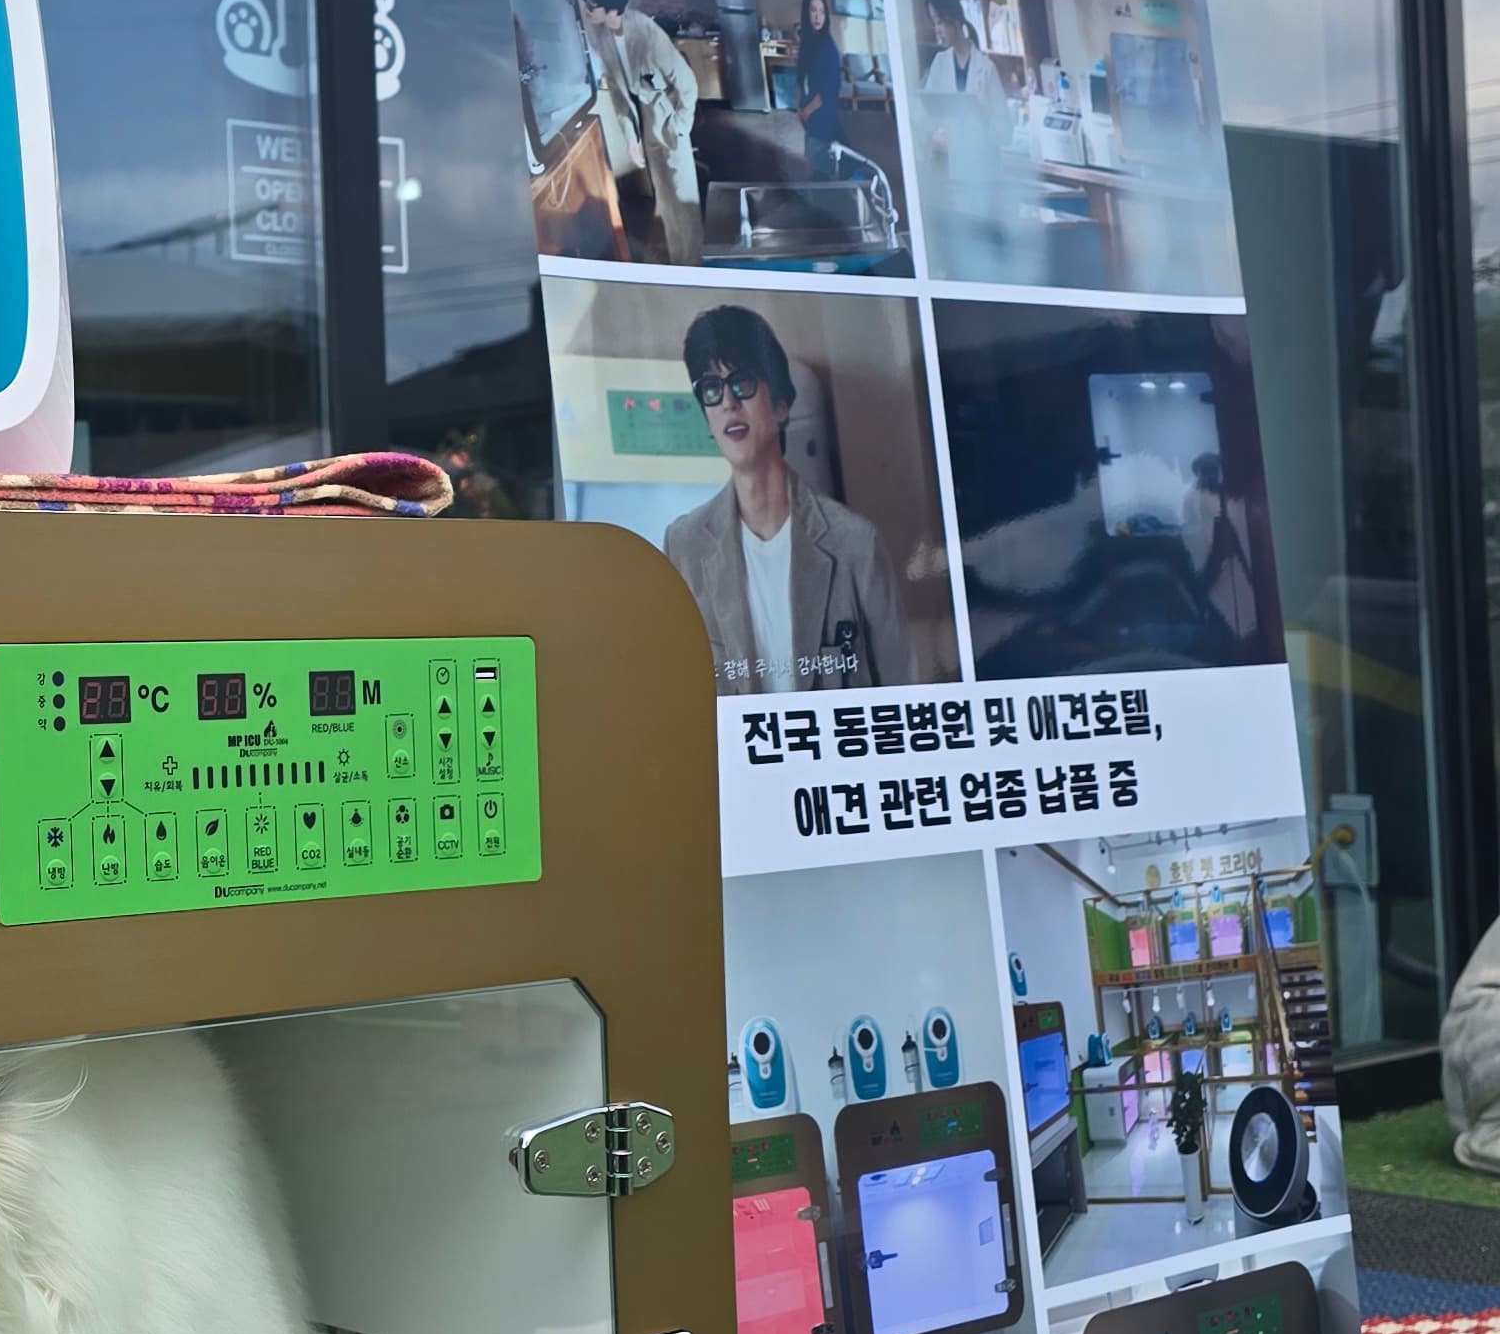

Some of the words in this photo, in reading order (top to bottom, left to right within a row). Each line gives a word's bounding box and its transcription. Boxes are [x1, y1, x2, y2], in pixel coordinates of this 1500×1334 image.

[798, 653, 859, 676] 감사합니다
[362, 680, 381, 705] M
[311, 722, 355, 735] RED/BLUE
[742, 709, 821, 765] 전국
[834, 699, 975, 758] 동물병원
[984, 697, 1020, 745] 및
[1027, 689, 1162, 742] 애견호텔,
[227, 735, 242, 747] MP
[244, 734, 261, 747] ICU
[477, 765, 501, 776] MUSIC
[794, 782, 871, 837] 애견
[880, 775, 951, 830] 관련
[960, 768, 1027, 823] 업종
[1036, 762, 1099, 812] 납품
[1108, 759, 1138, 807] 중
[437, 839, 459, 850] CCTV
[254, 846, 272, 857] RED
[301, 849, 321, 860] CO2
[101, 863, 120, 876] 난방
[154, 858, 172, 870] 습도
[252, 858, 275, 869] BLUE
